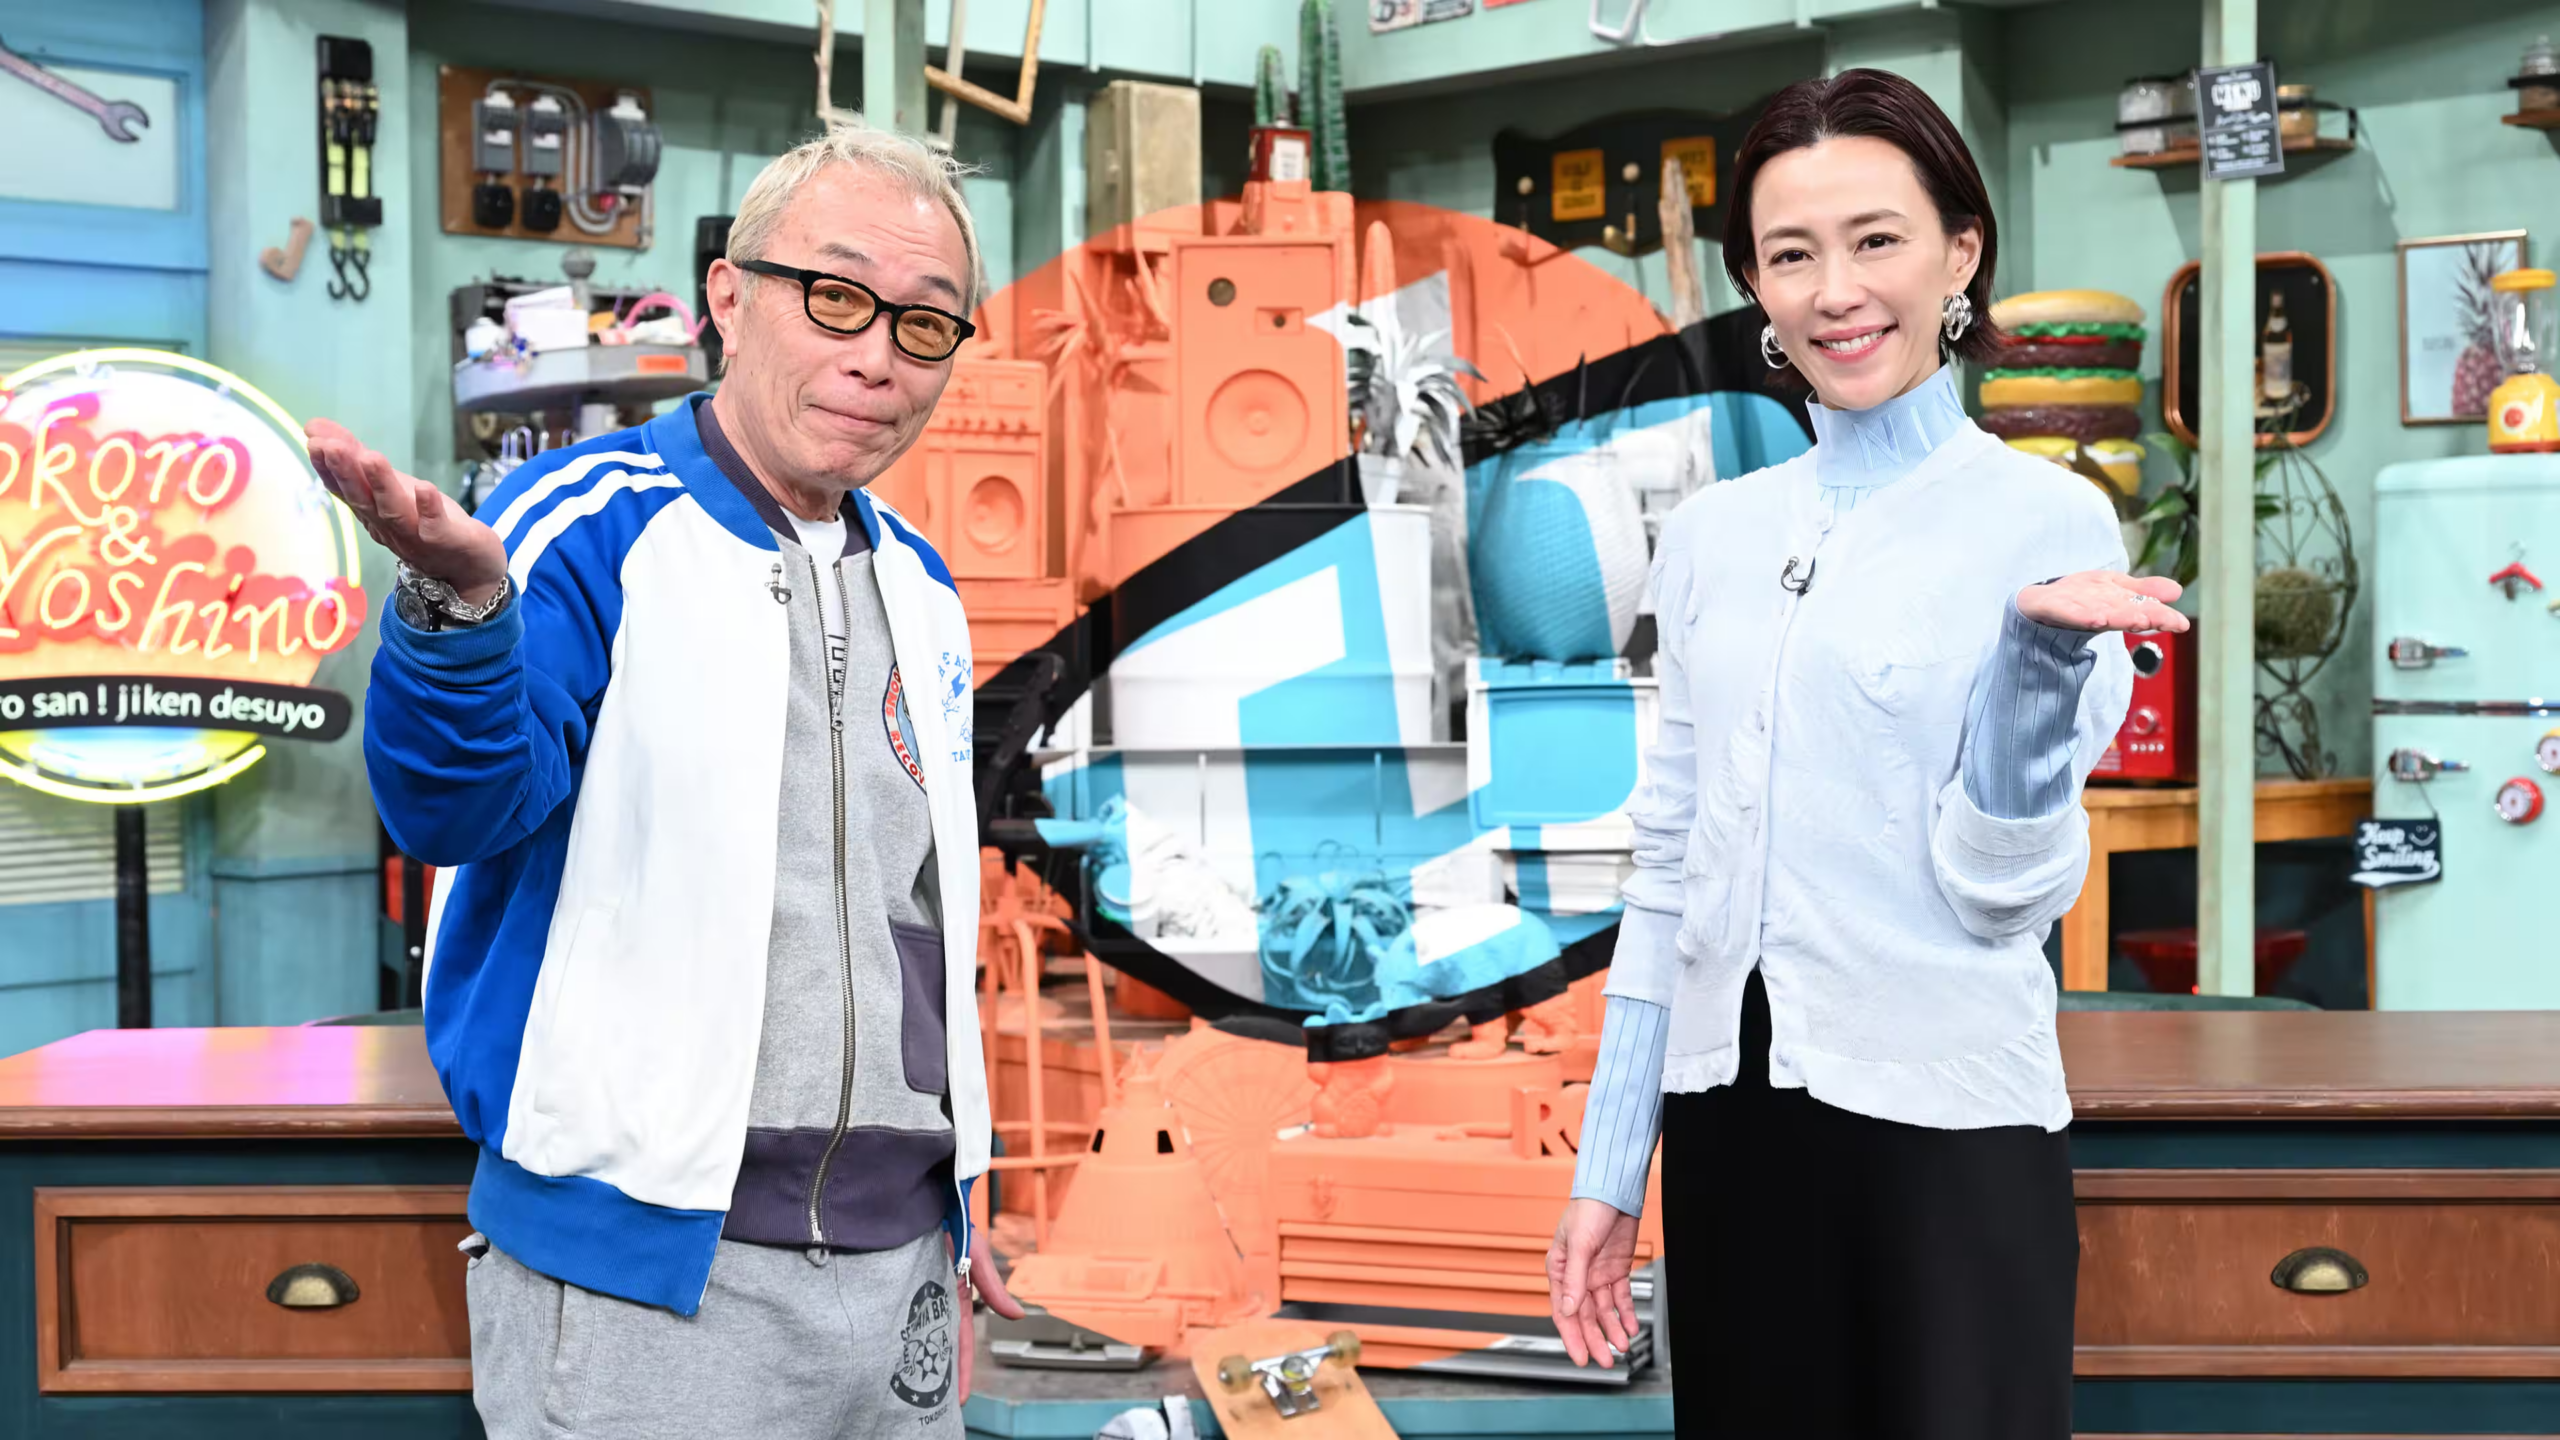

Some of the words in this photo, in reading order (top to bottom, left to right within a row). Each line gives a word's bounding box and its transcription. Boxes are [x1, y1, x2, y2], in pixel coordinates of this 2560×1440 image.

[99, 505, 158, 567] &
[0, 525, 347, 662] Yoshino
[0, 694, 25, 720] o
[32, 690, 89, 718] san
[97, 683, 108, 716] !
[114, 683, 201, 724] jiken
[209, 687, 326, 733] desuyo
[2360, 844, 2435, 871] Smiling
